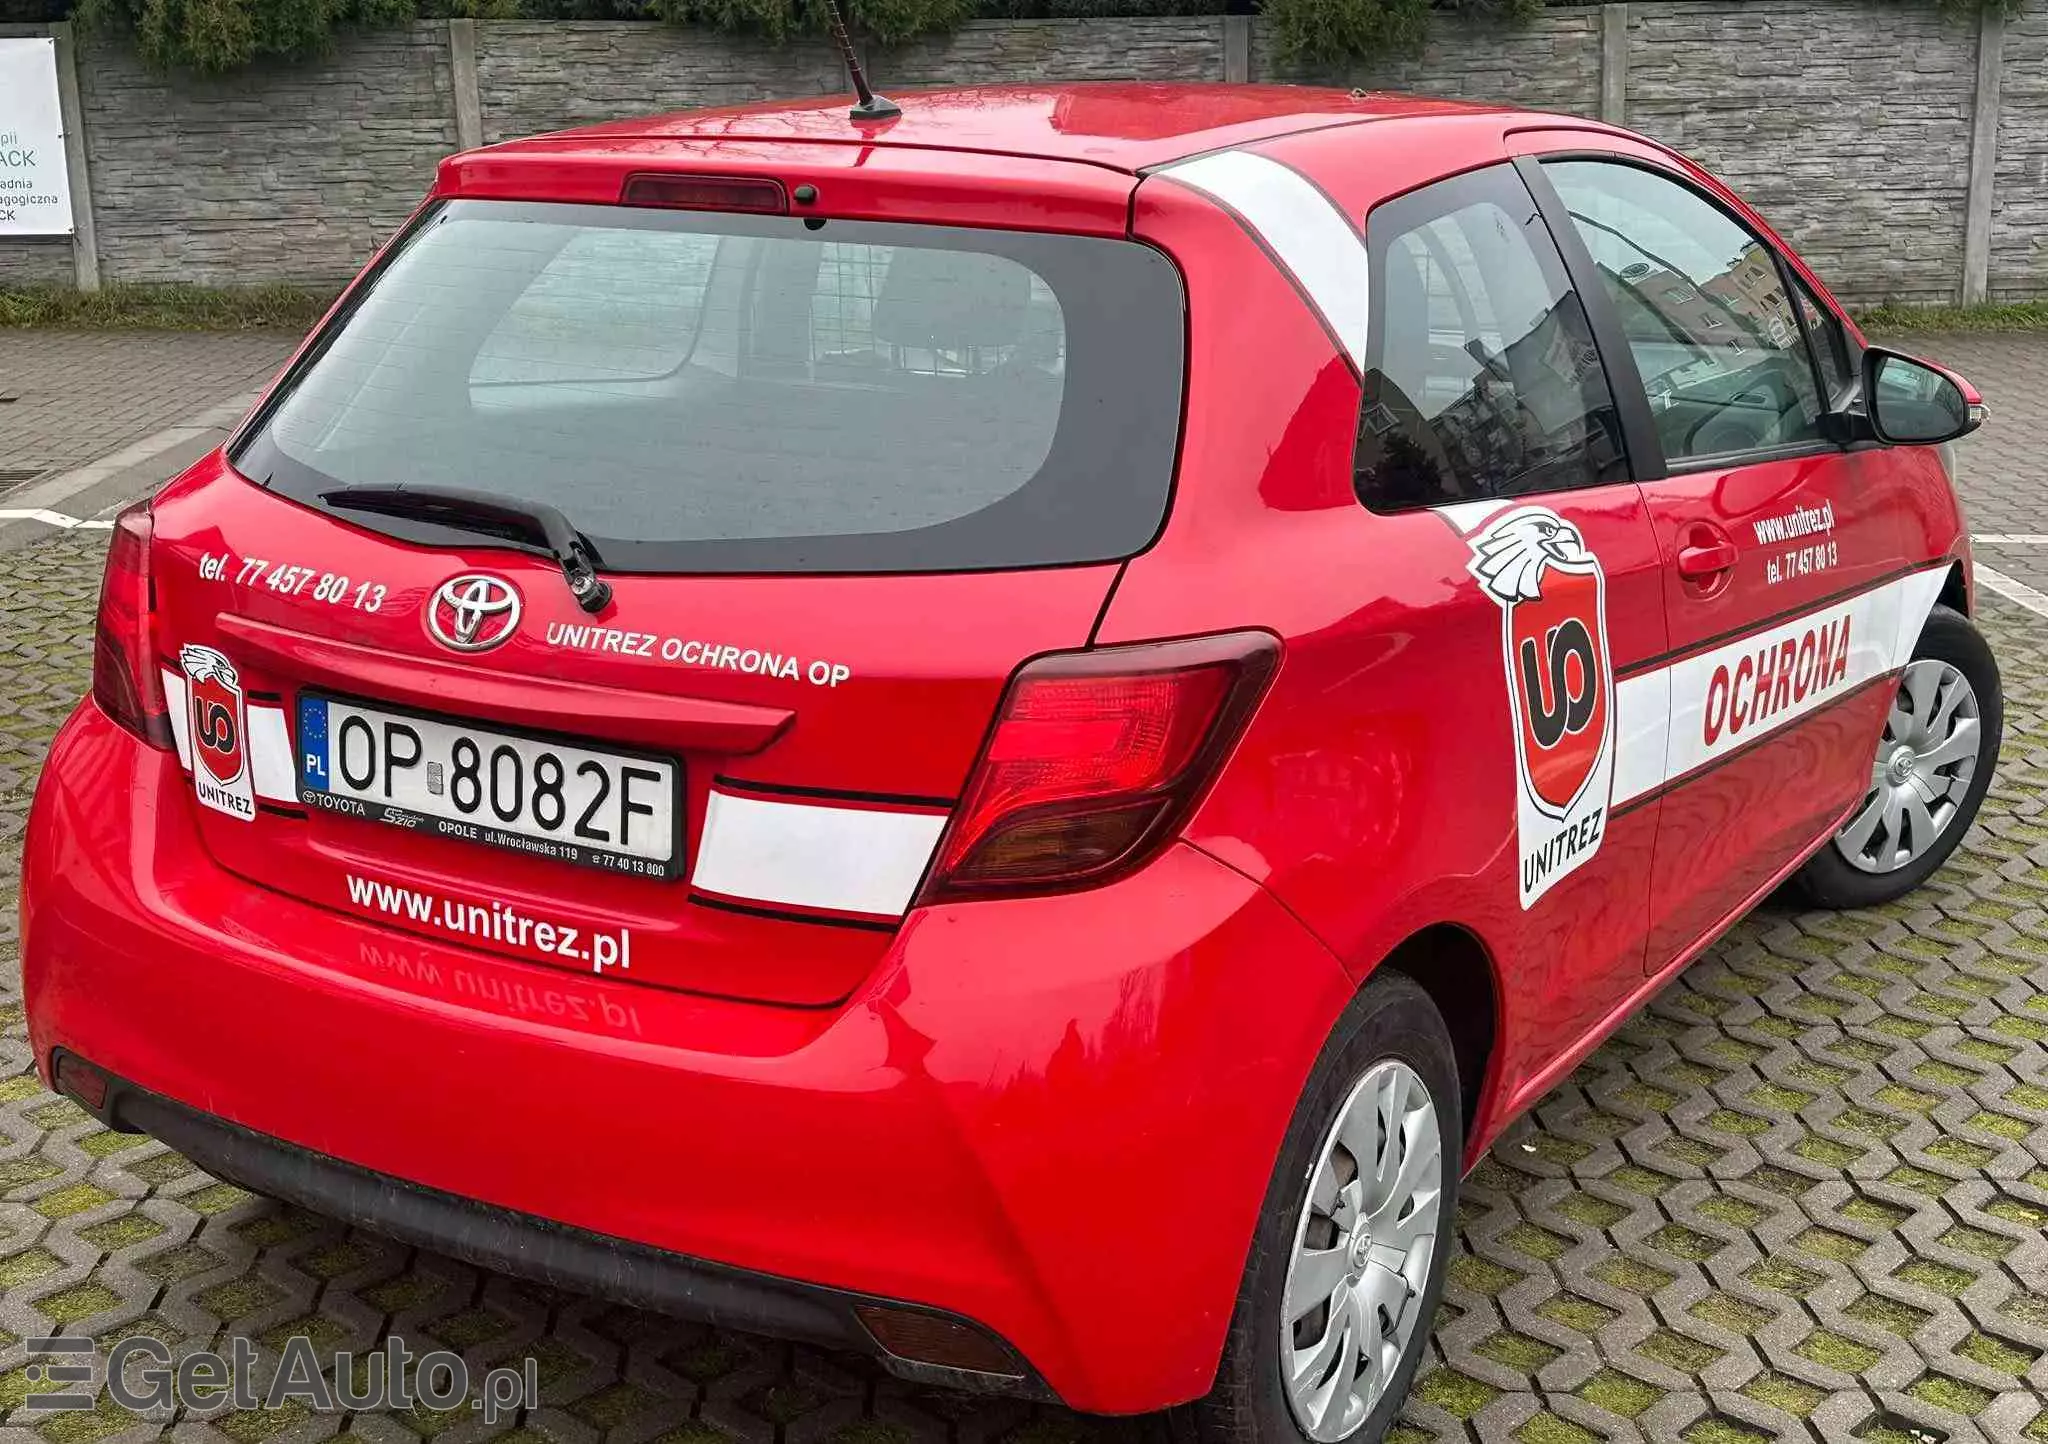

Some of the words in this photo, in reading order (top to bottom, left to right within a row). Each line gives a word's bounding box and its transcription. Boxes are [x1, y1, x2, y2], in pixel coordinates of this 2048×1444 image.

[1753, 499, 1834, 545] www.unitrez.pl
[200, 552, 229, 581] tel.
[236, 557, 270, 586] 77
[266, 564, 316, 596] 457
[313, 573, 350, 604] 80
[353, 581, 387, 613] 13
[1767, 556, 1782, 584] tel.
[1786, 552, 1797, 579] 77
[1798, 547, 1813, 575] 457
[1815, 544, 1826, 571] 80
[1827, 540, 1837, 567] 13
[546, 622, 657, 657] UNITREZ
[661, 638, 800, 681] OCHRONA
[808, 661, 850, 688] OP
[1704, 615, 1853, 747] OCHRONA
[198, 782, 252, 815] UNITREZ
[305, 754, 326, 777] PL
[339, 715, 423, 798] OP
[450, 736, 661, 846] 8082F
[316, 793, 366, 816] TOYOTA
[438, 821, 478, 839] OPOLE
[559, 846, 578, 860] 119
[603, 854, 615, 867] 77
[617, 857, 630, 870] 40
[632, 860, 644, 873] 13
[646, 862, 665, 876] 800
[1524, 807, 1603, 893] UNITREZ
[347, 875, 630, 973] www.unitrez.pl
